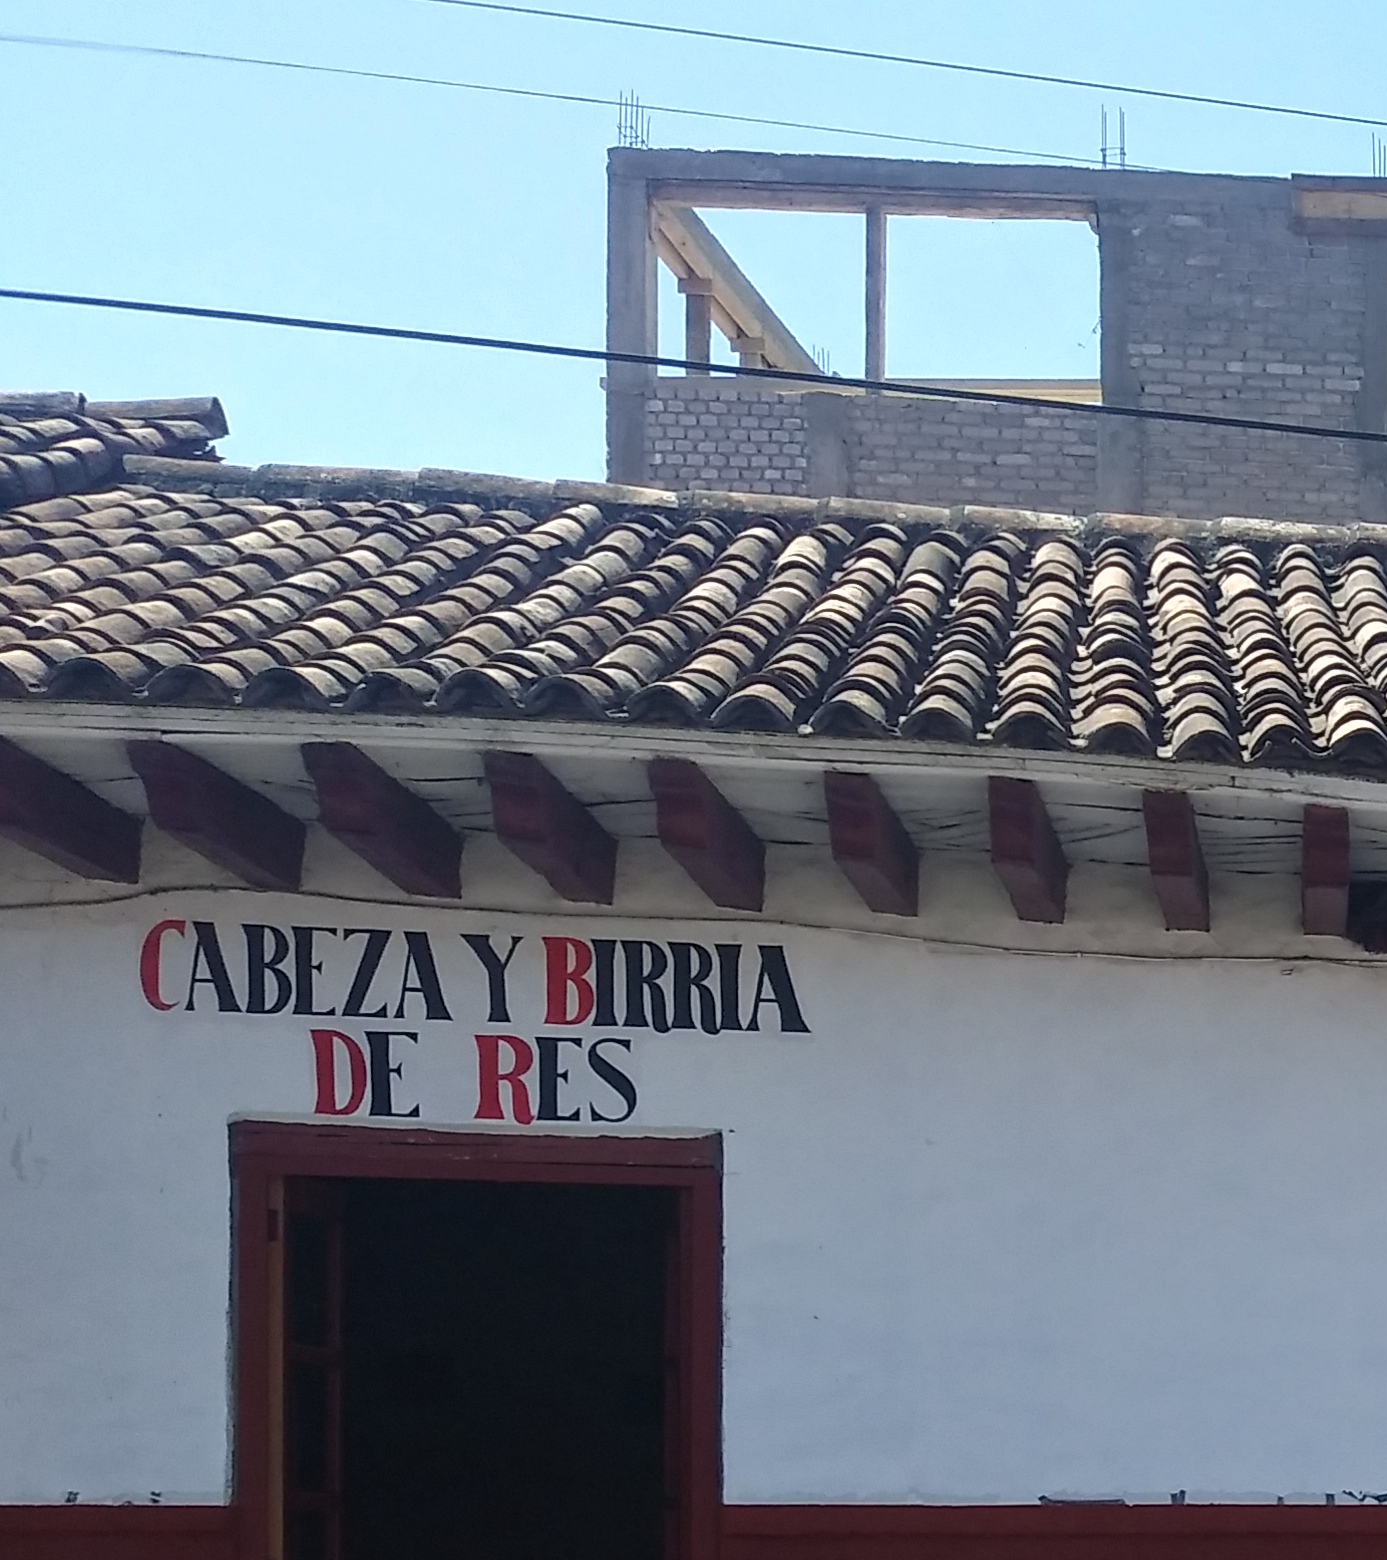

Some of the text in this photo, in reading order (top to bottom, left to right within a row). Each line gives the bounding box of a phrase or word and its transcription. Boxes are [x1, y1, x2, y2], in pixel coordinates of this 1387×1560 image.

[140, 920, 811, 1035] CABEZA Y BIRRIA
[309, 1029, 637, 1125] DE RES
